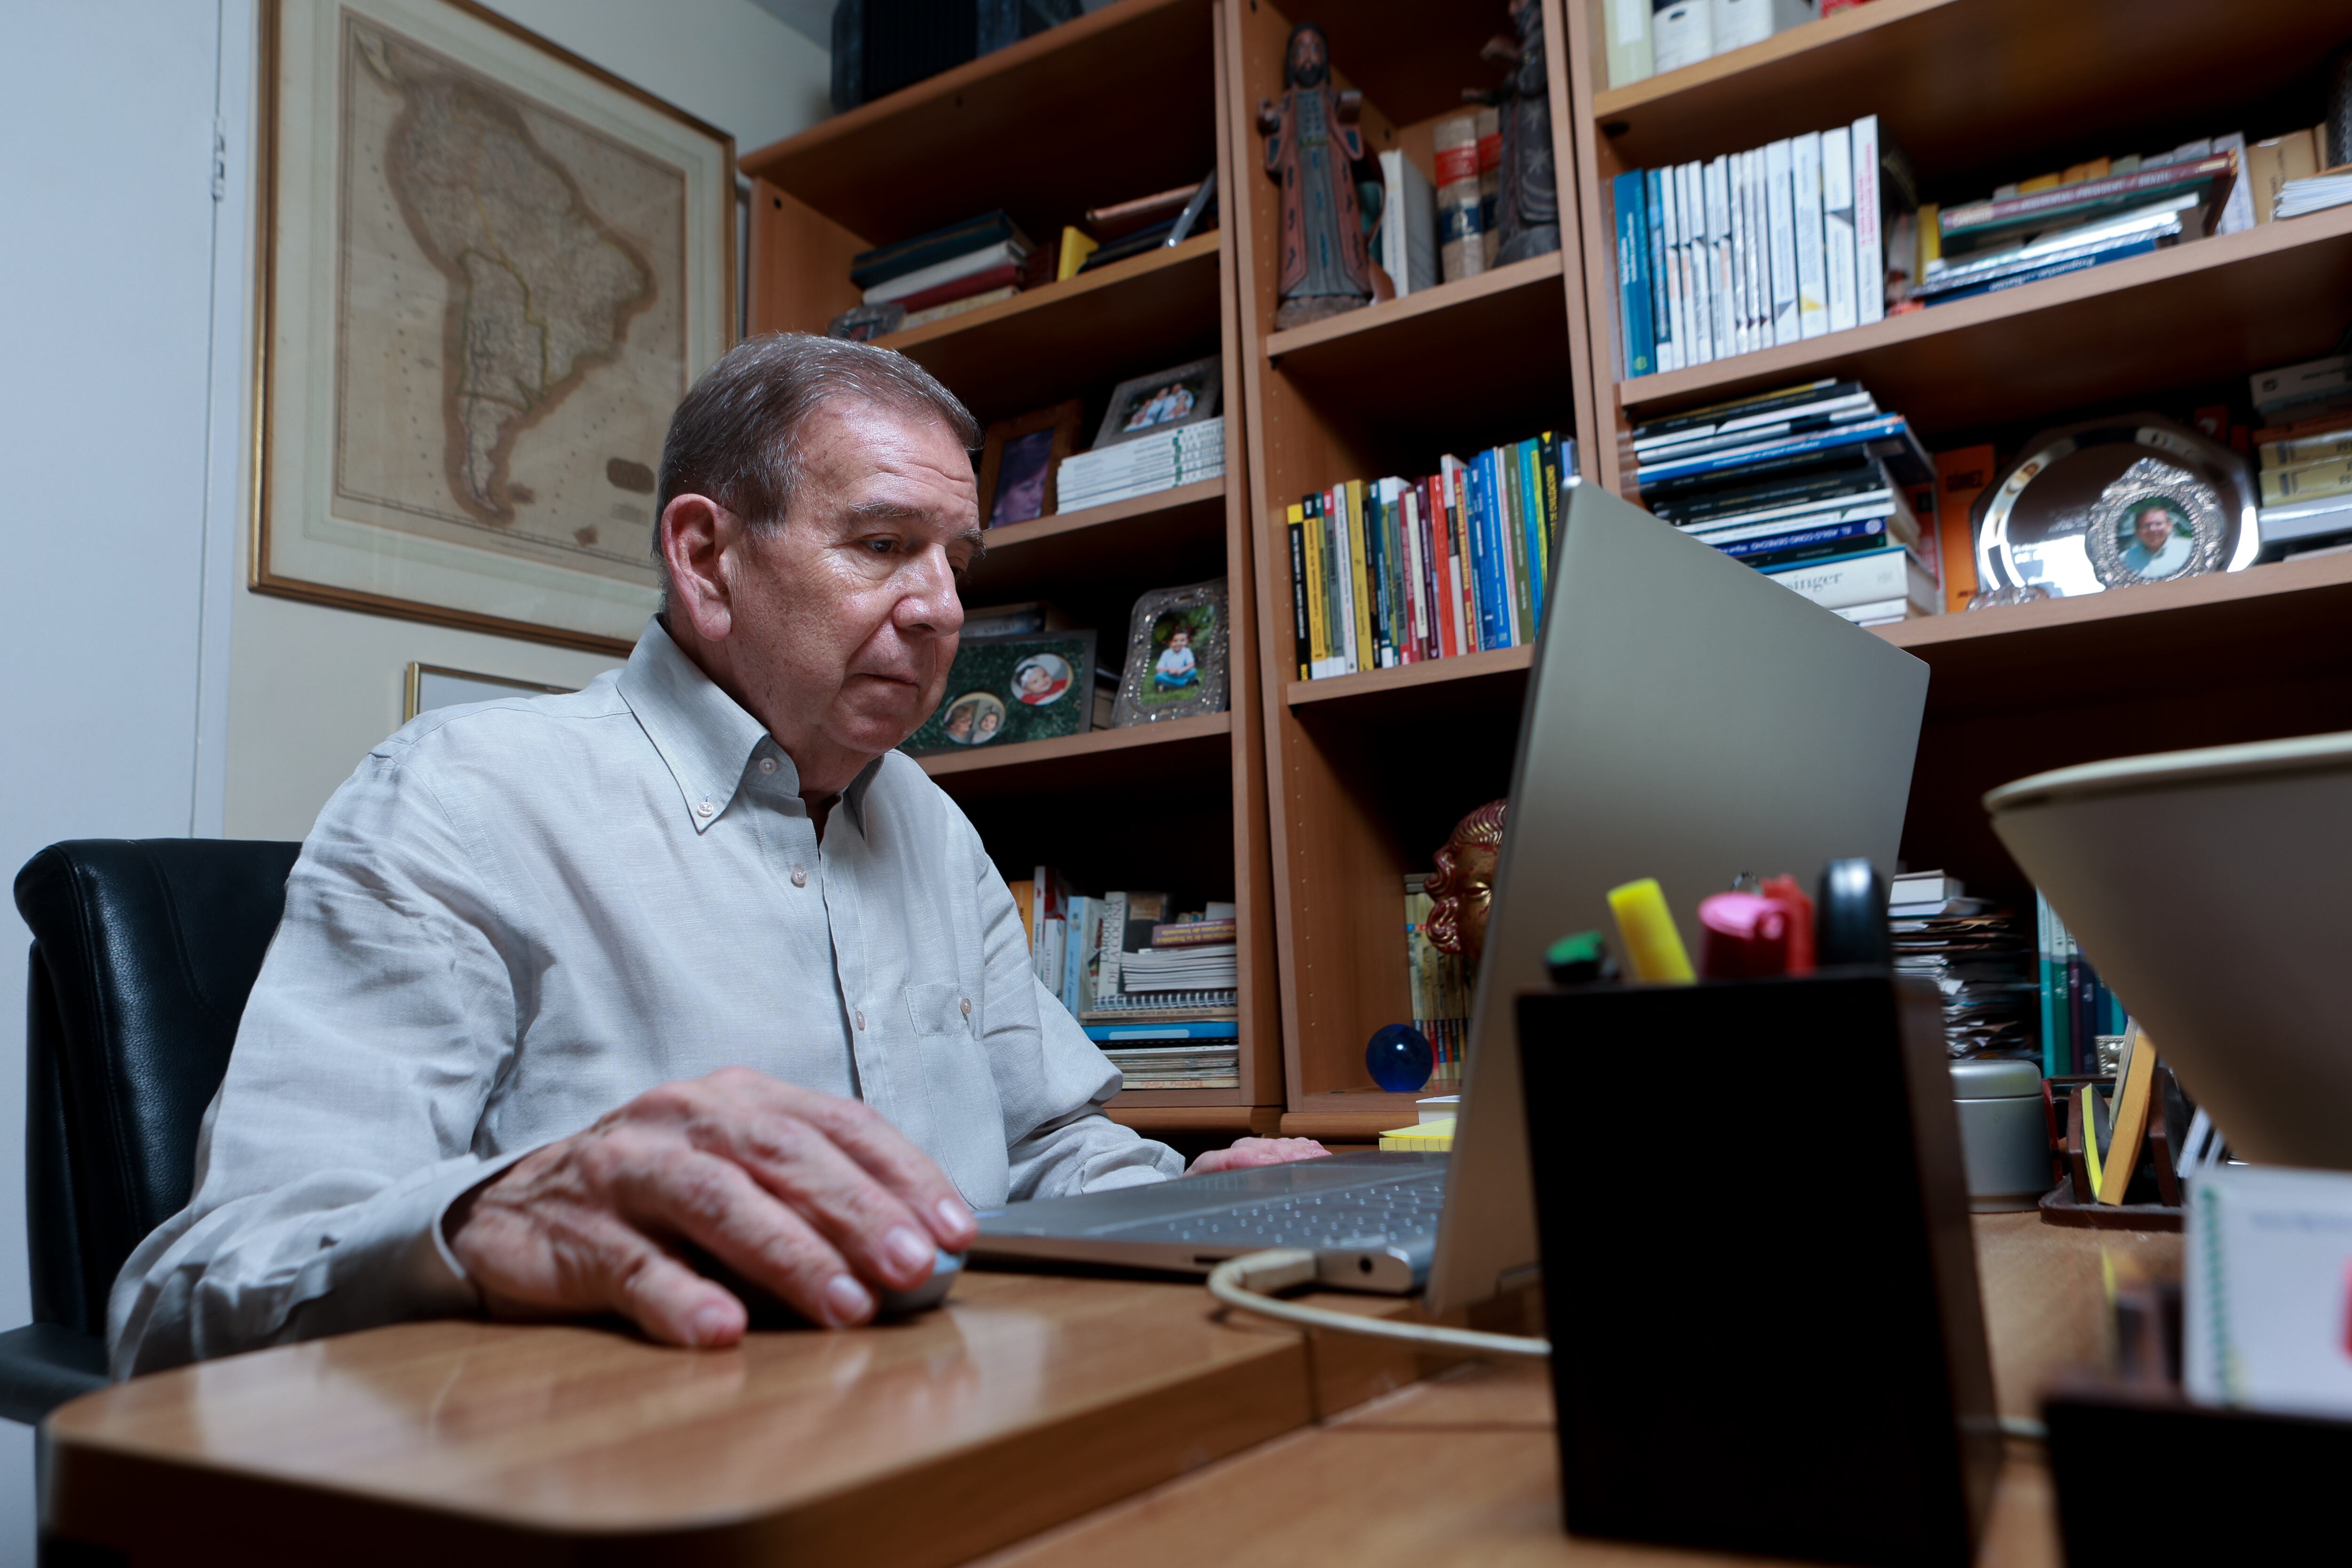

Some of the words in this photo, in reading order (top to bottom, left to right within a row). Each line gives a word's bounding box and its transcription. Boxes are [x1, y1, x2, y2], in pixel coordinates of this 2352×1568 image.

[1786, 572, 1843, 593] singer
[1099, 902, 1112, 963] LAROUSSE
[1110, 899, 1122, 947] COCINA
[1109, 951, 1120, 964] LA
[1107, 969, 1119, 984] DE
